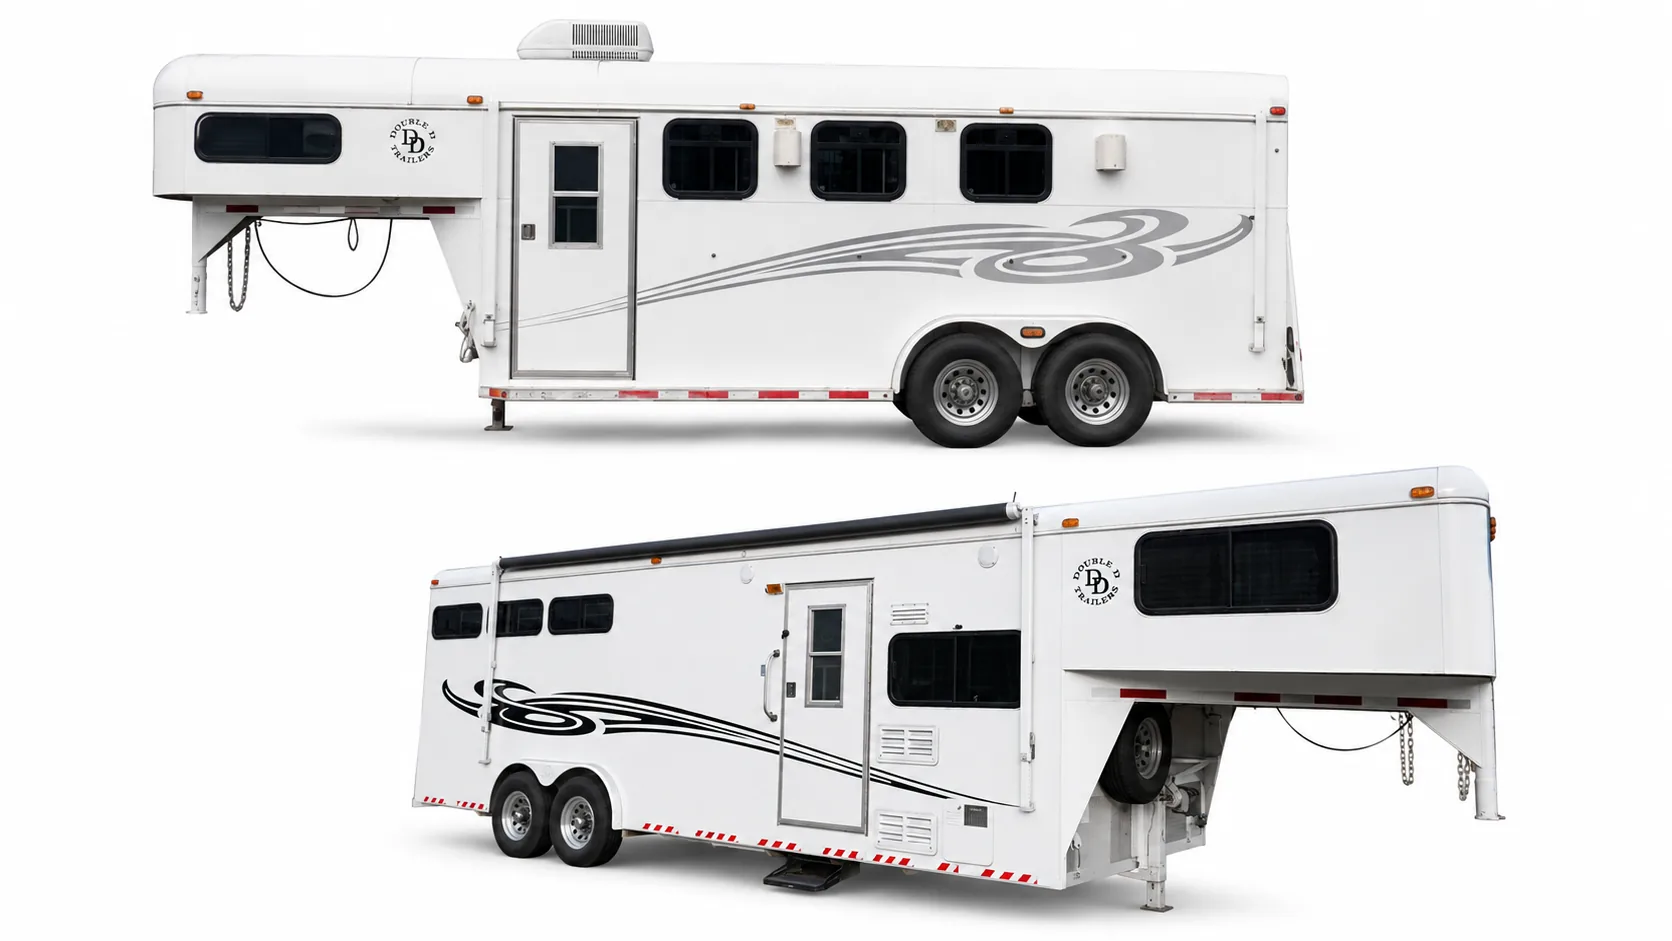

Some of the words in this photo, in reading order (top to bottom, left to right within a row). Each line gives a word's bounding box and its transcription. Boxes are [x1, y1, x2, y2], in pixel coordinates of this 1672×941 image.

[390, 118, 429, 139] DOUBLE
[428, 130, 436, 140] D
[390, 144, 435, 164] TRAILERS
[1072, 557, 1113, 580] DOUBLE
[1112, 568, 1121, 579] D
[1073, 585, 1119, 606] TRAILERS
